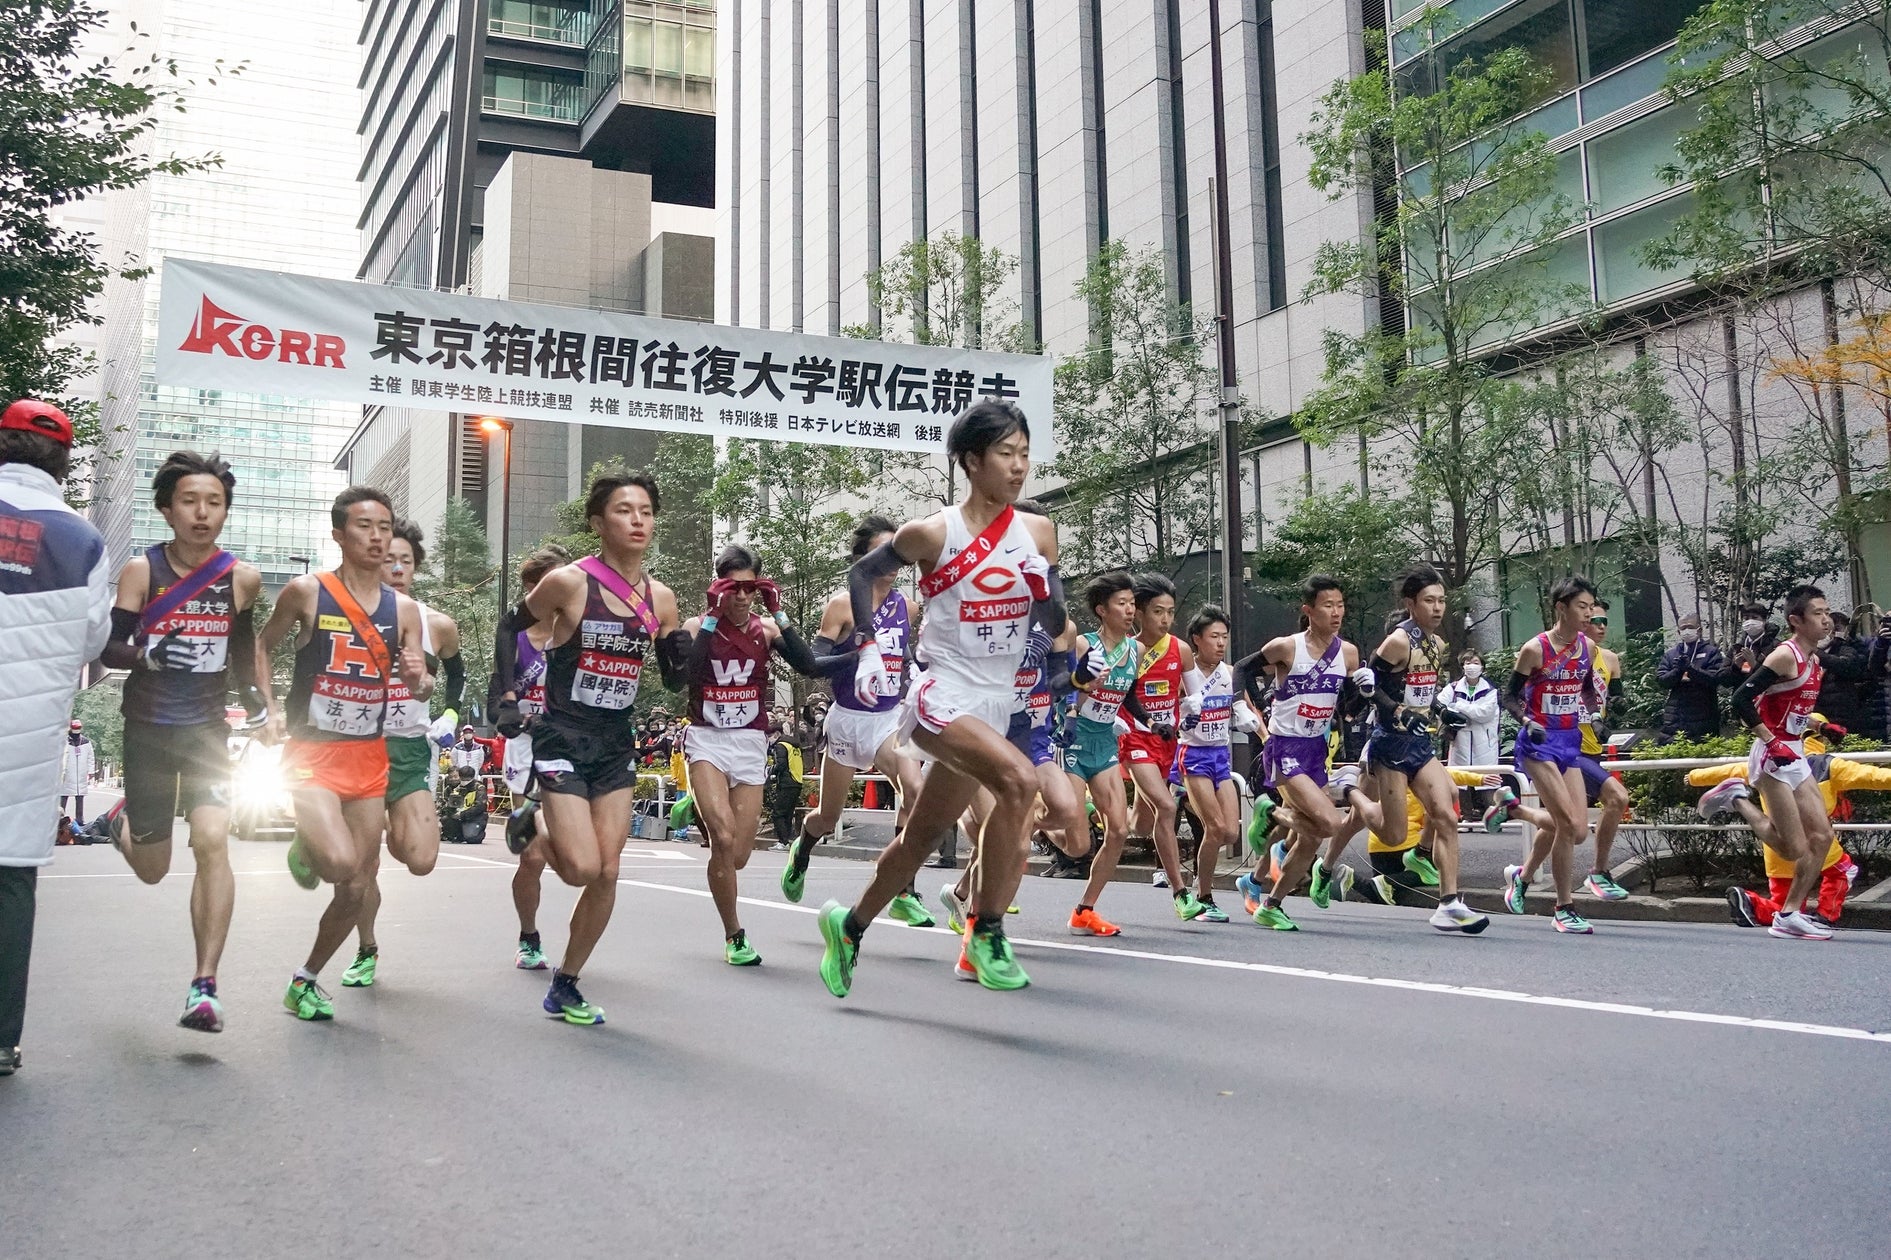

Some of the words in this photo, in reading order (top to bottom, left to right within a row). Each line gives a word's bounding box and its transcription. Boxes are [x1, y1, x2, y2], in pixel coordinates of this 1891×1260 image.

[369, 374, 402, 395] 主催
[411, 379, 573, 411] 関東学生陸上競技連盟
[589, 396, 620, 416] 共催
[628, 400, 704, 423] 読売新聞社
[719, 408, 778, 429] 特別後援
[788, 415, 901, 439] 日本テレビ放送網
[914, 425, 943, 442] 後援
[979, 601, 1028, 618] SAPPORO
[169, 619, 229, 633] SAPPORO
[711, 659, 756, 686] W
[333, 683, 383, 700] SAPPORO
[716, 690, 757, 701] SAPPORO
[391, 701, 406, 717] 大
